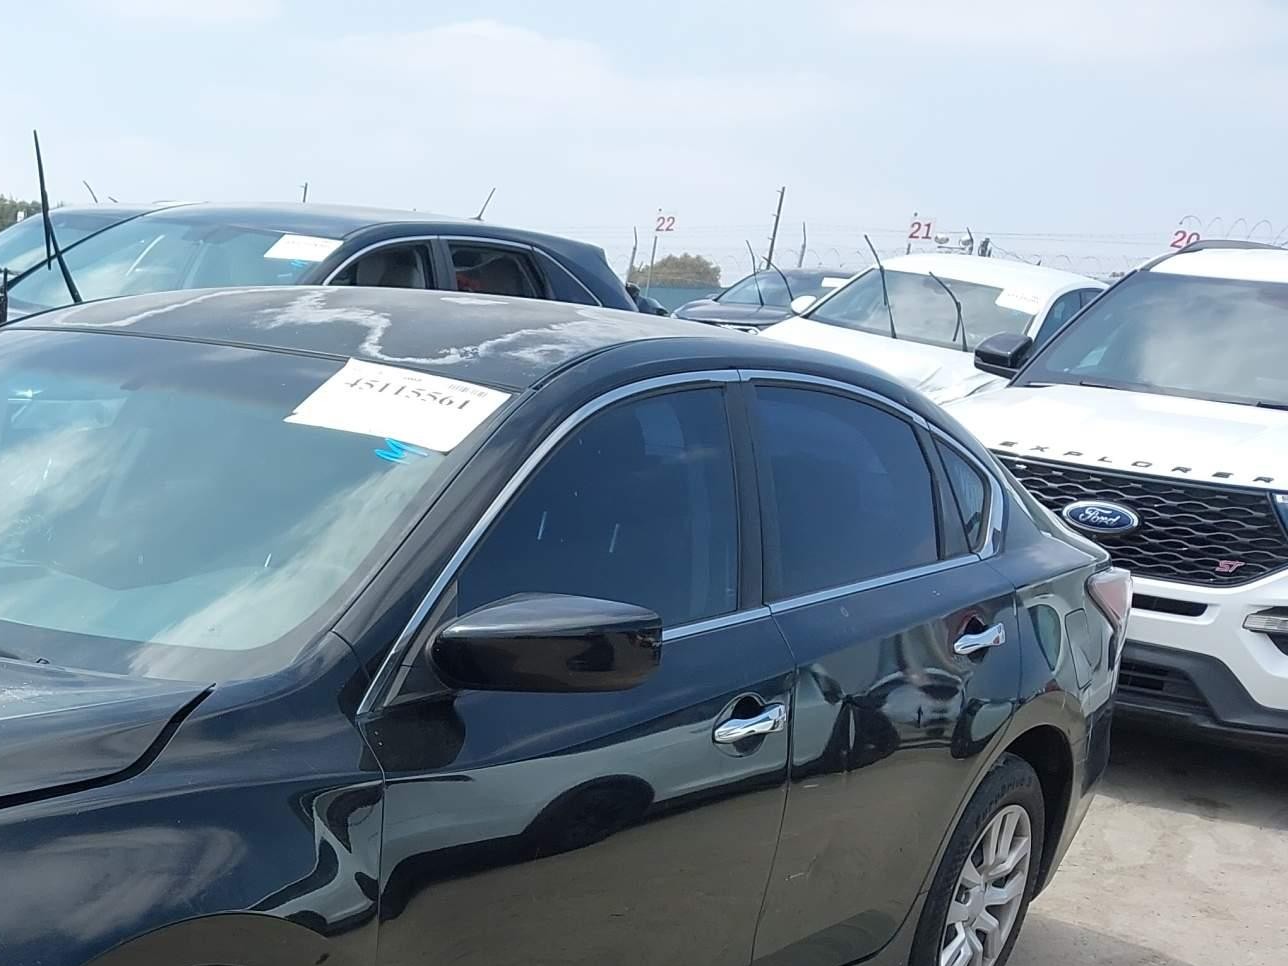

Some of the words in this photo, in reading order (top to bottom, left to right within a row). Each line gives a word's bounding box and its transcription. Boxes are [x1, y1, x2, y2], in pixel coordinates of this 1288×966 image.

[655, 216, 676, 232] 22
[908, 221, 932, 240] 21
[343, 377, 471, 410] 45115561
[999, 440, 1275, 484] EXPLORER
[1077, 506, 1122, 527] Ford
[1215, 559, 1246, 573] ST
